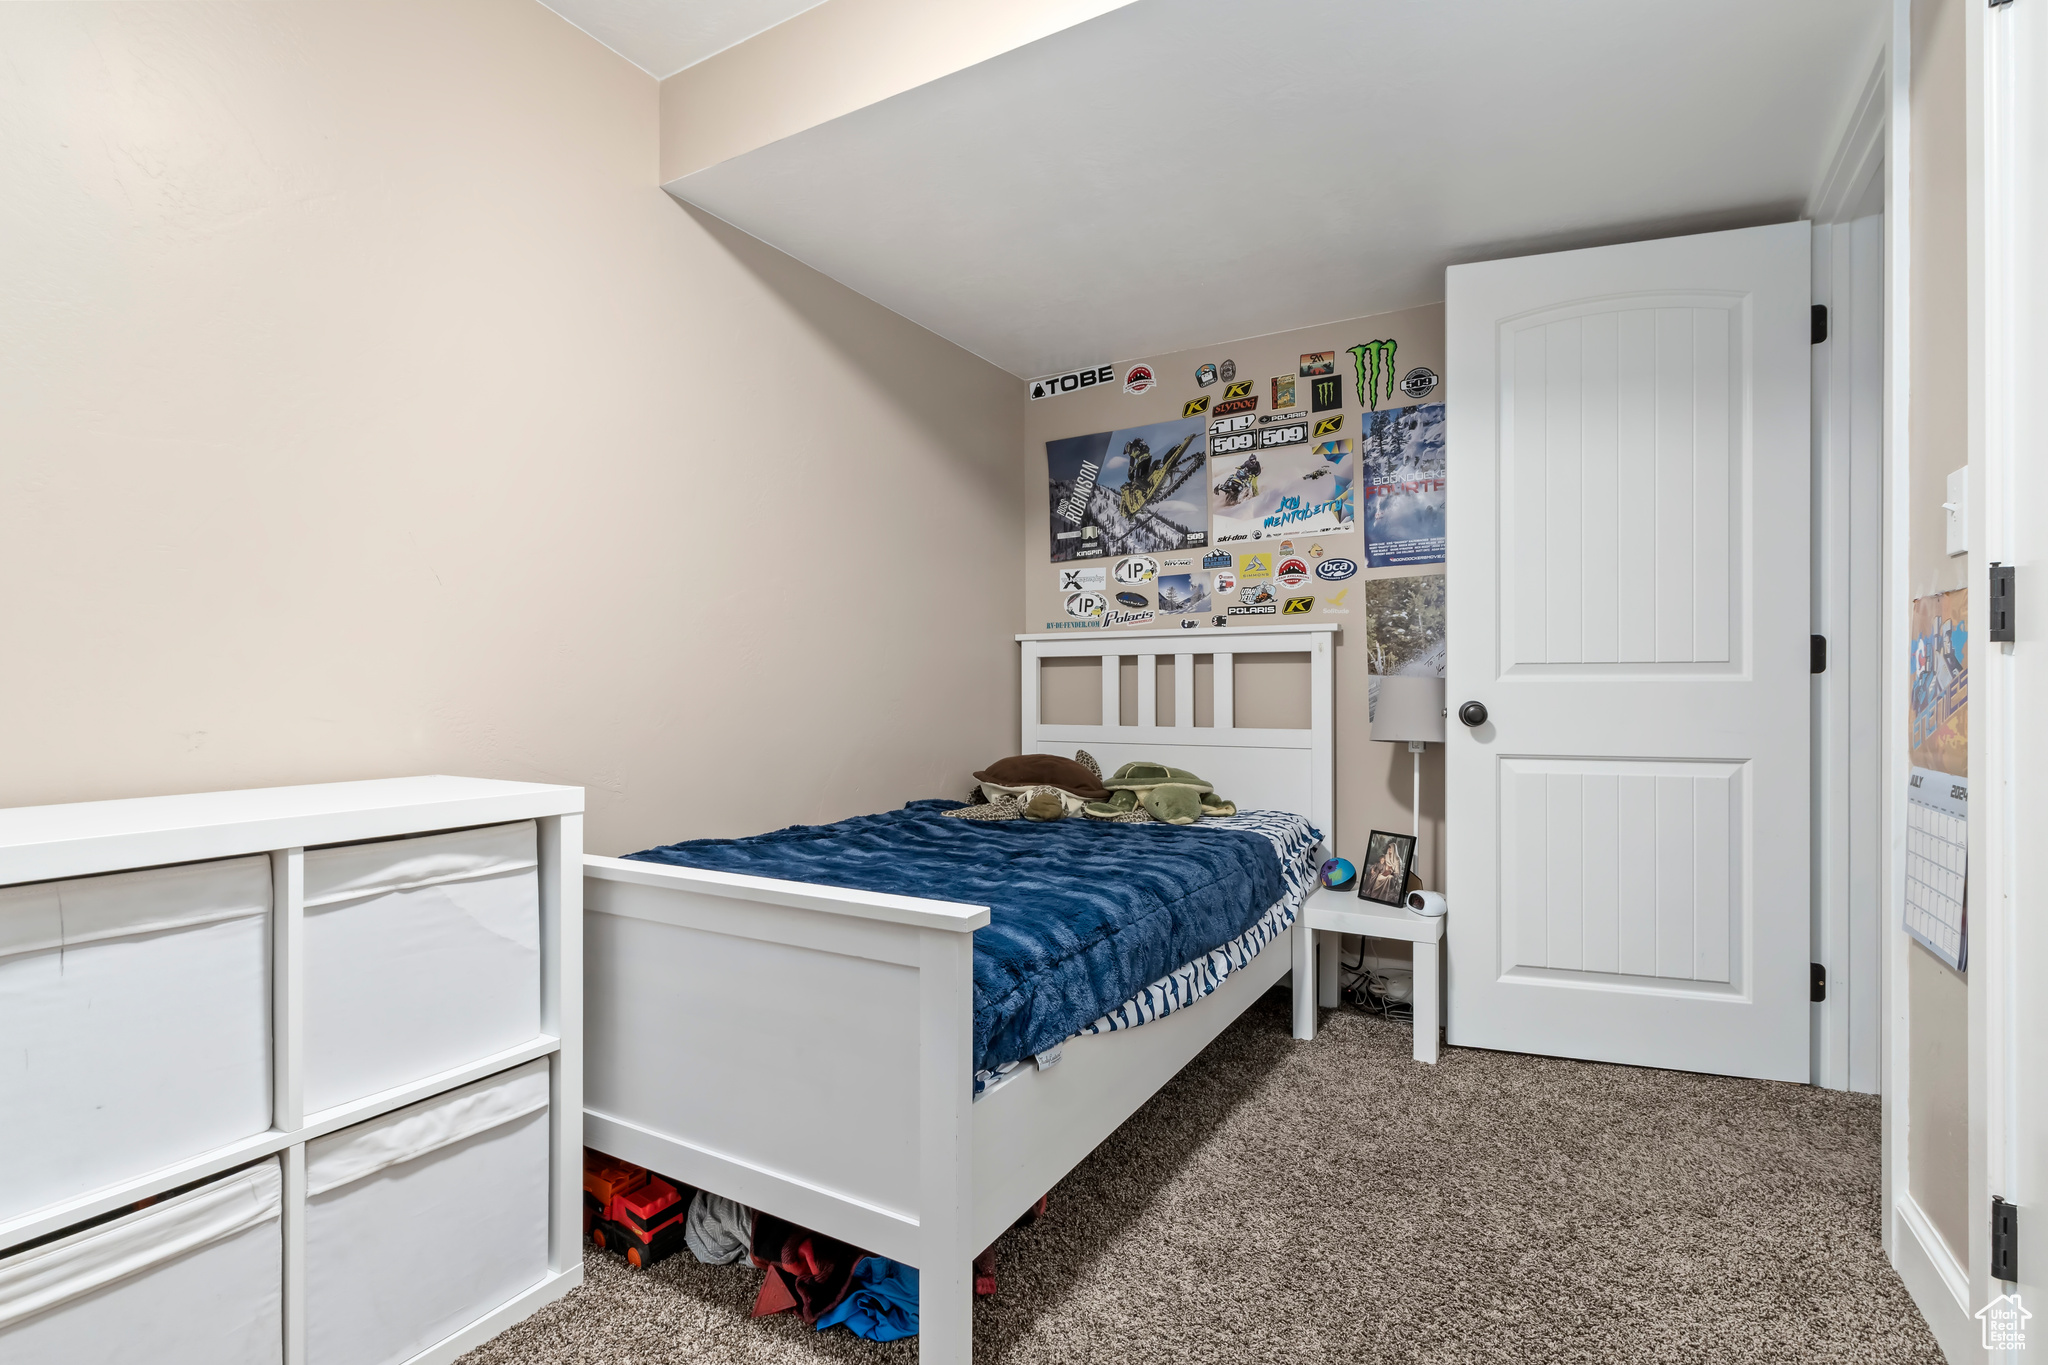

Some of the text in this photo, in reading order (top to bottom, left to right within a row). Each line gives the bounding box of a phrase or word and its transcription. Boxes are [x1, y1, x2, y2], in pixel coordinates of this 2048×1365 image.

[1046, 365, 1114, 395] TOBE
[1215, 399, 1255, 414] SLYDOG
[1271, 411, 1307, 422] POLARIS
[1262, 426, 1304, 445] 509
[1214, 434, 1253, 453] 509
[1065, 460, 1099, 525] ROBINSON
[1057, 498, 1069, 516] ROSS
[1216, 534, 1248, 543] ski-doo
[1128, 563, 1144, 578] IP
[1324, 562, 1348, 572] bca
[1241, 588, 1257, 596] UTAH
[1241, 594, 1253, 602] YETI
[1079, 598, 1094, 612] IP
[1228, 606, 1276, 615] POLARIS
[1102, 610, 1154, 627] Polaris
[1910, 774, 1968, 801] JULY 2024
